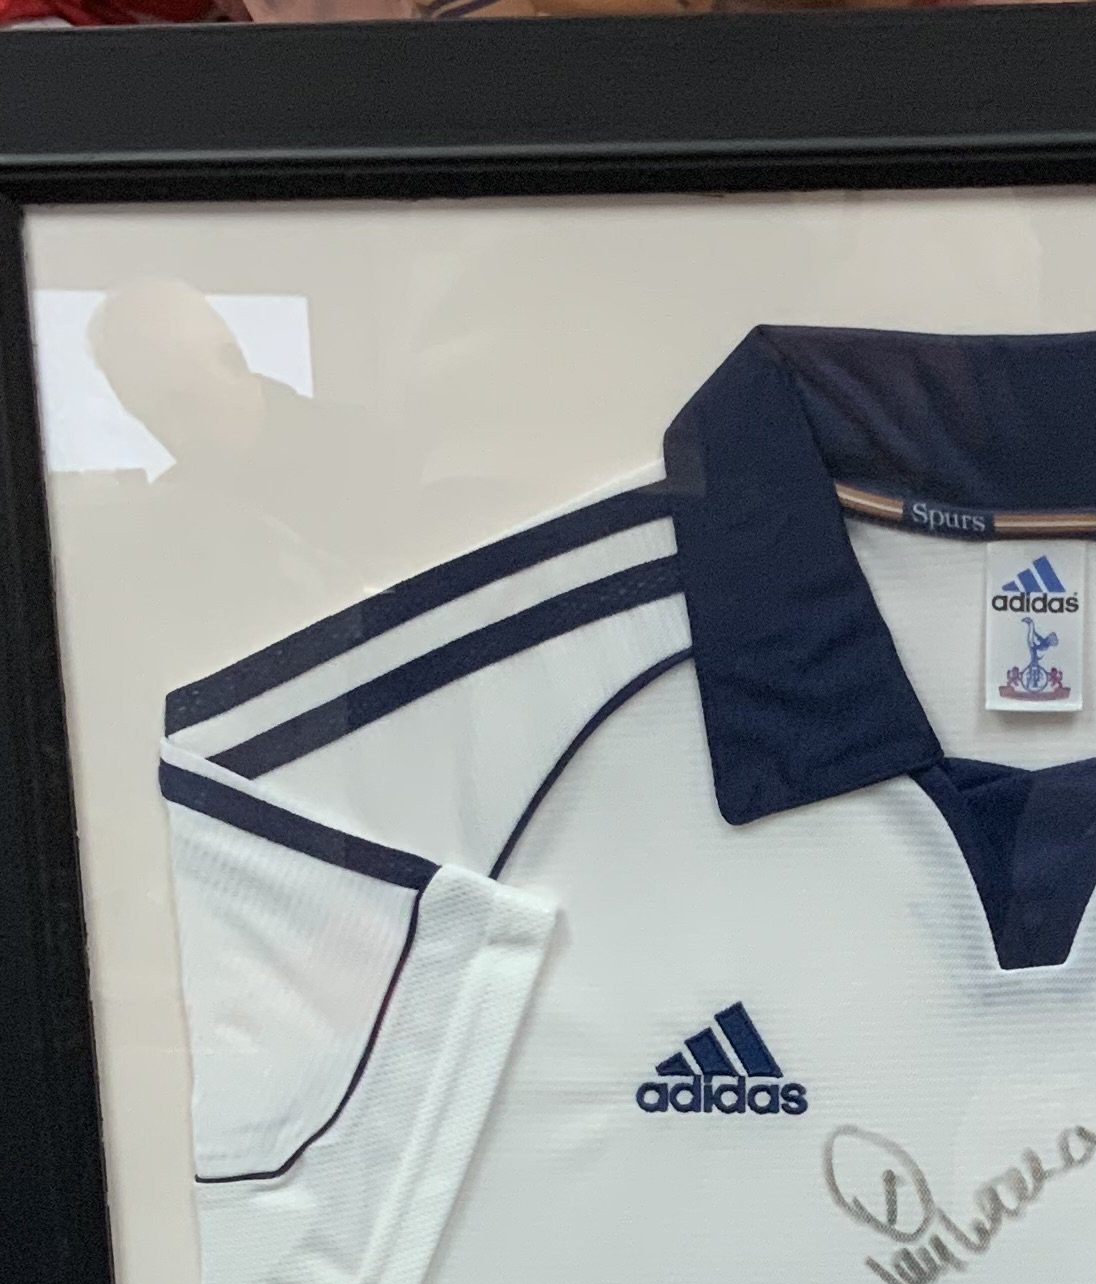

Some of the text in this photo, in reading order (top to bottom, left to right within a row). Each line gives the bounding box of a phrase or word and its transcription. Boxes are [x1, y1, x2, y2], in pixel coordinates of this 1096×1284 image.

[912, 502, 985, 532] Spurs
[991, 592, 1079, 614] adidas
[636, 1073, 808, 1115] adidas
